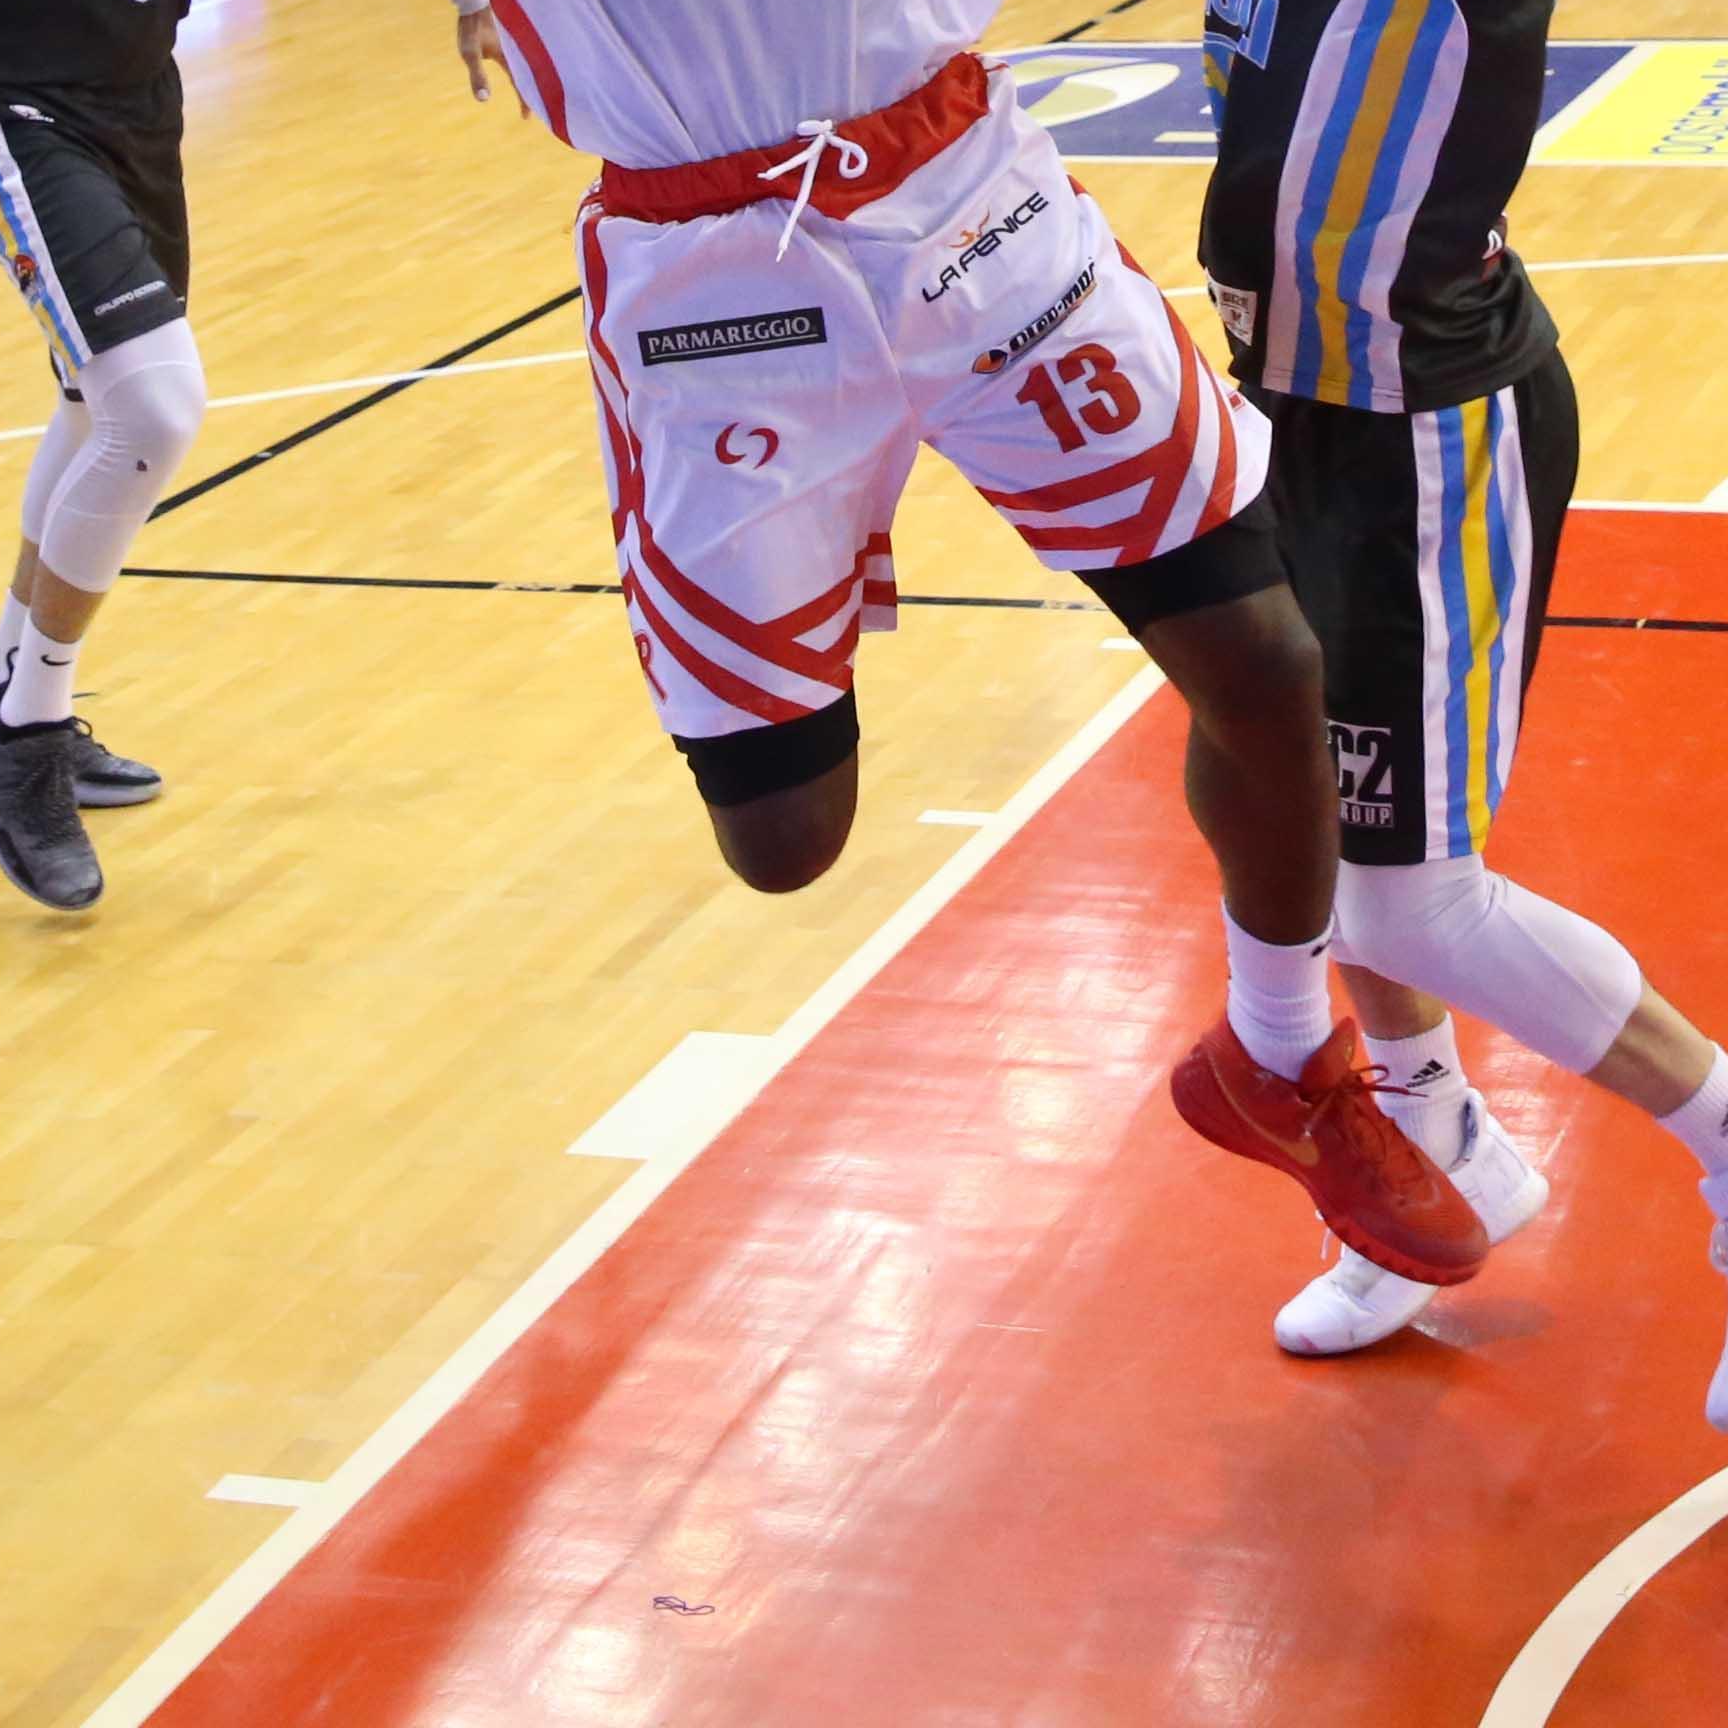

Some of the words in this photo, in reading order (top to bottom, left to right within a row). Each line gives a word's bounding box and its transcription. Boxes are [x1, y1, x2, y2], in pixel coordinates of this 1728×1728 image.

[922, 264, 961, 304] LA
[958, 191, 1050, 273] FENICE
[647, 314, 813, 356] PARMAREGGIO
[1015, 342, 1141, 454] 13
[1340, 803, 1393, 826] ROUP
